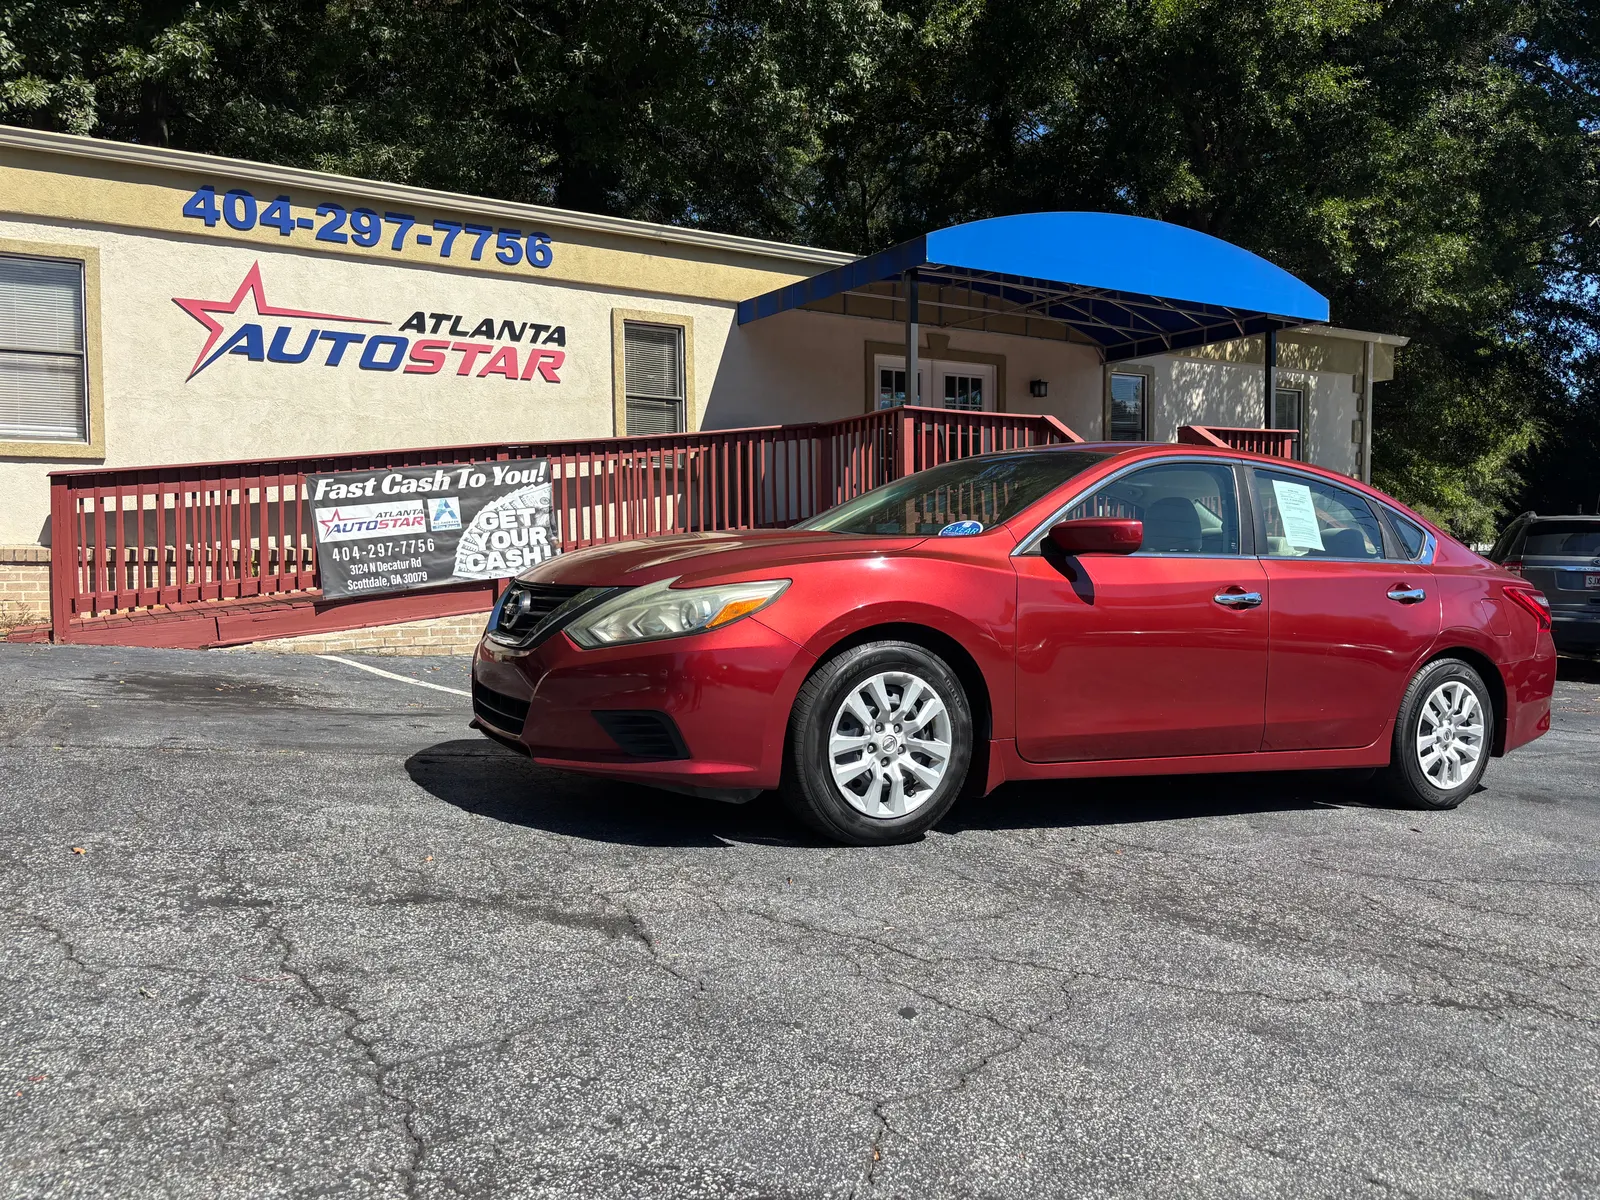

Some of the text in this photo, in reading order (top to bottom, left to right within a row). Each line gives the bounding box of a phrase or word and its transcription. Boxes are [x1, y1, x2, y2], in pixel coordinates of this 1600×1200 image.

[182, 184, 554, 269] 404-297-7756
[398, 311, 566, 348] ATLANTA
[190, 322, 567, 384] AUTOSTAR
[313, 461, 547, 501] Fast Cash To You!
[375, 508, 424, 519] ATLANTA
[479, 507, 536, 530] GET
[325, 516, 424, 537] AUTOSTAR
[470, 526, 548, 551] YOUR
[332, 538, 435, 562] 404-297-7756
[466, 545, 552, 572] CASH!
[350, 557, 422, 575] 3124 N Decatur Rd
[347, 571, 428, 590] Scottdale, GA 30079
